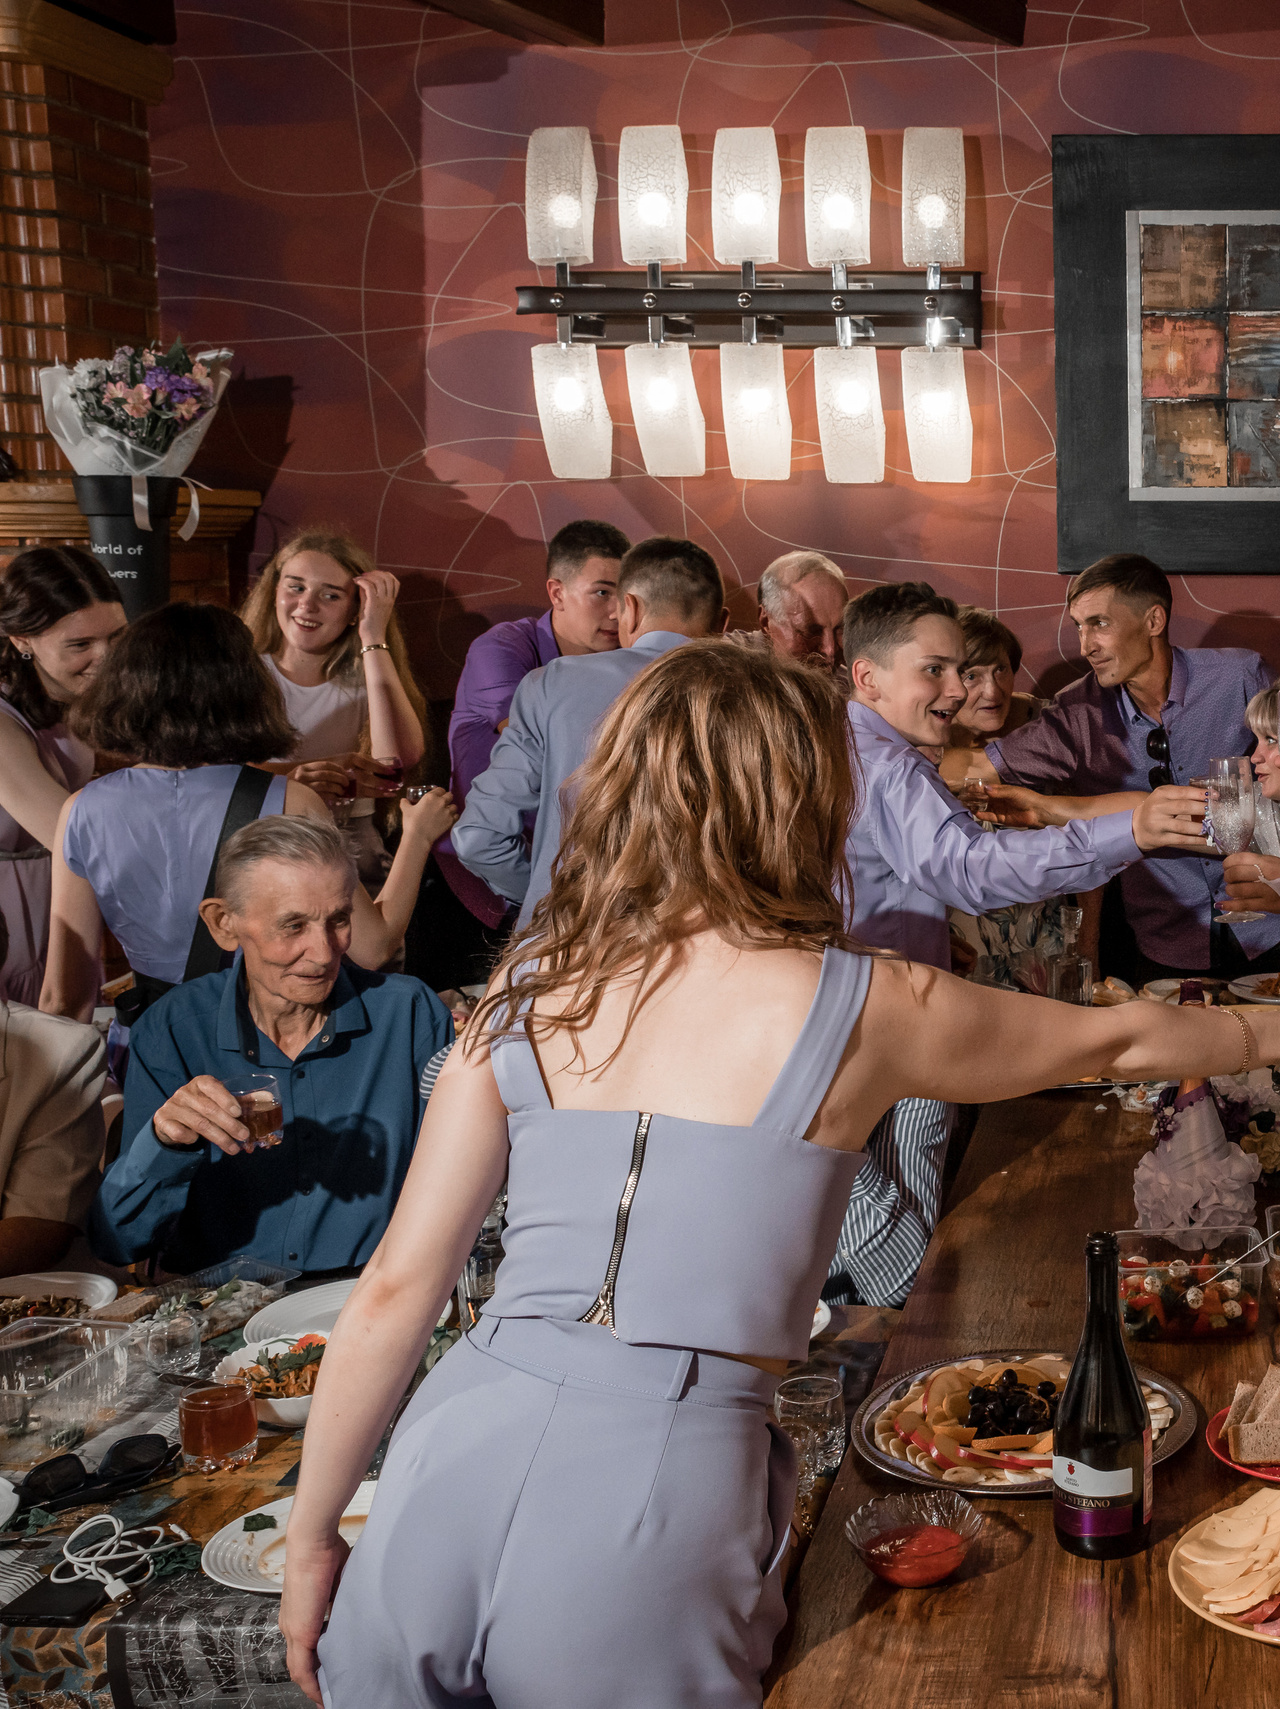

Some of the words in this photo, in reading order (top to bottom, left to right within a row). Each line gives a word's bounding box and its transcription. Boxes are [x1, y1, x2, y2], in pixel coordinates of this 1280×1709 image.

[91, 542, 122, 554] World
[127, 545, 143, 555] of
[108, 570, 138, 579] wers
[1068, 1495, 1110, 1508] STEFANO
